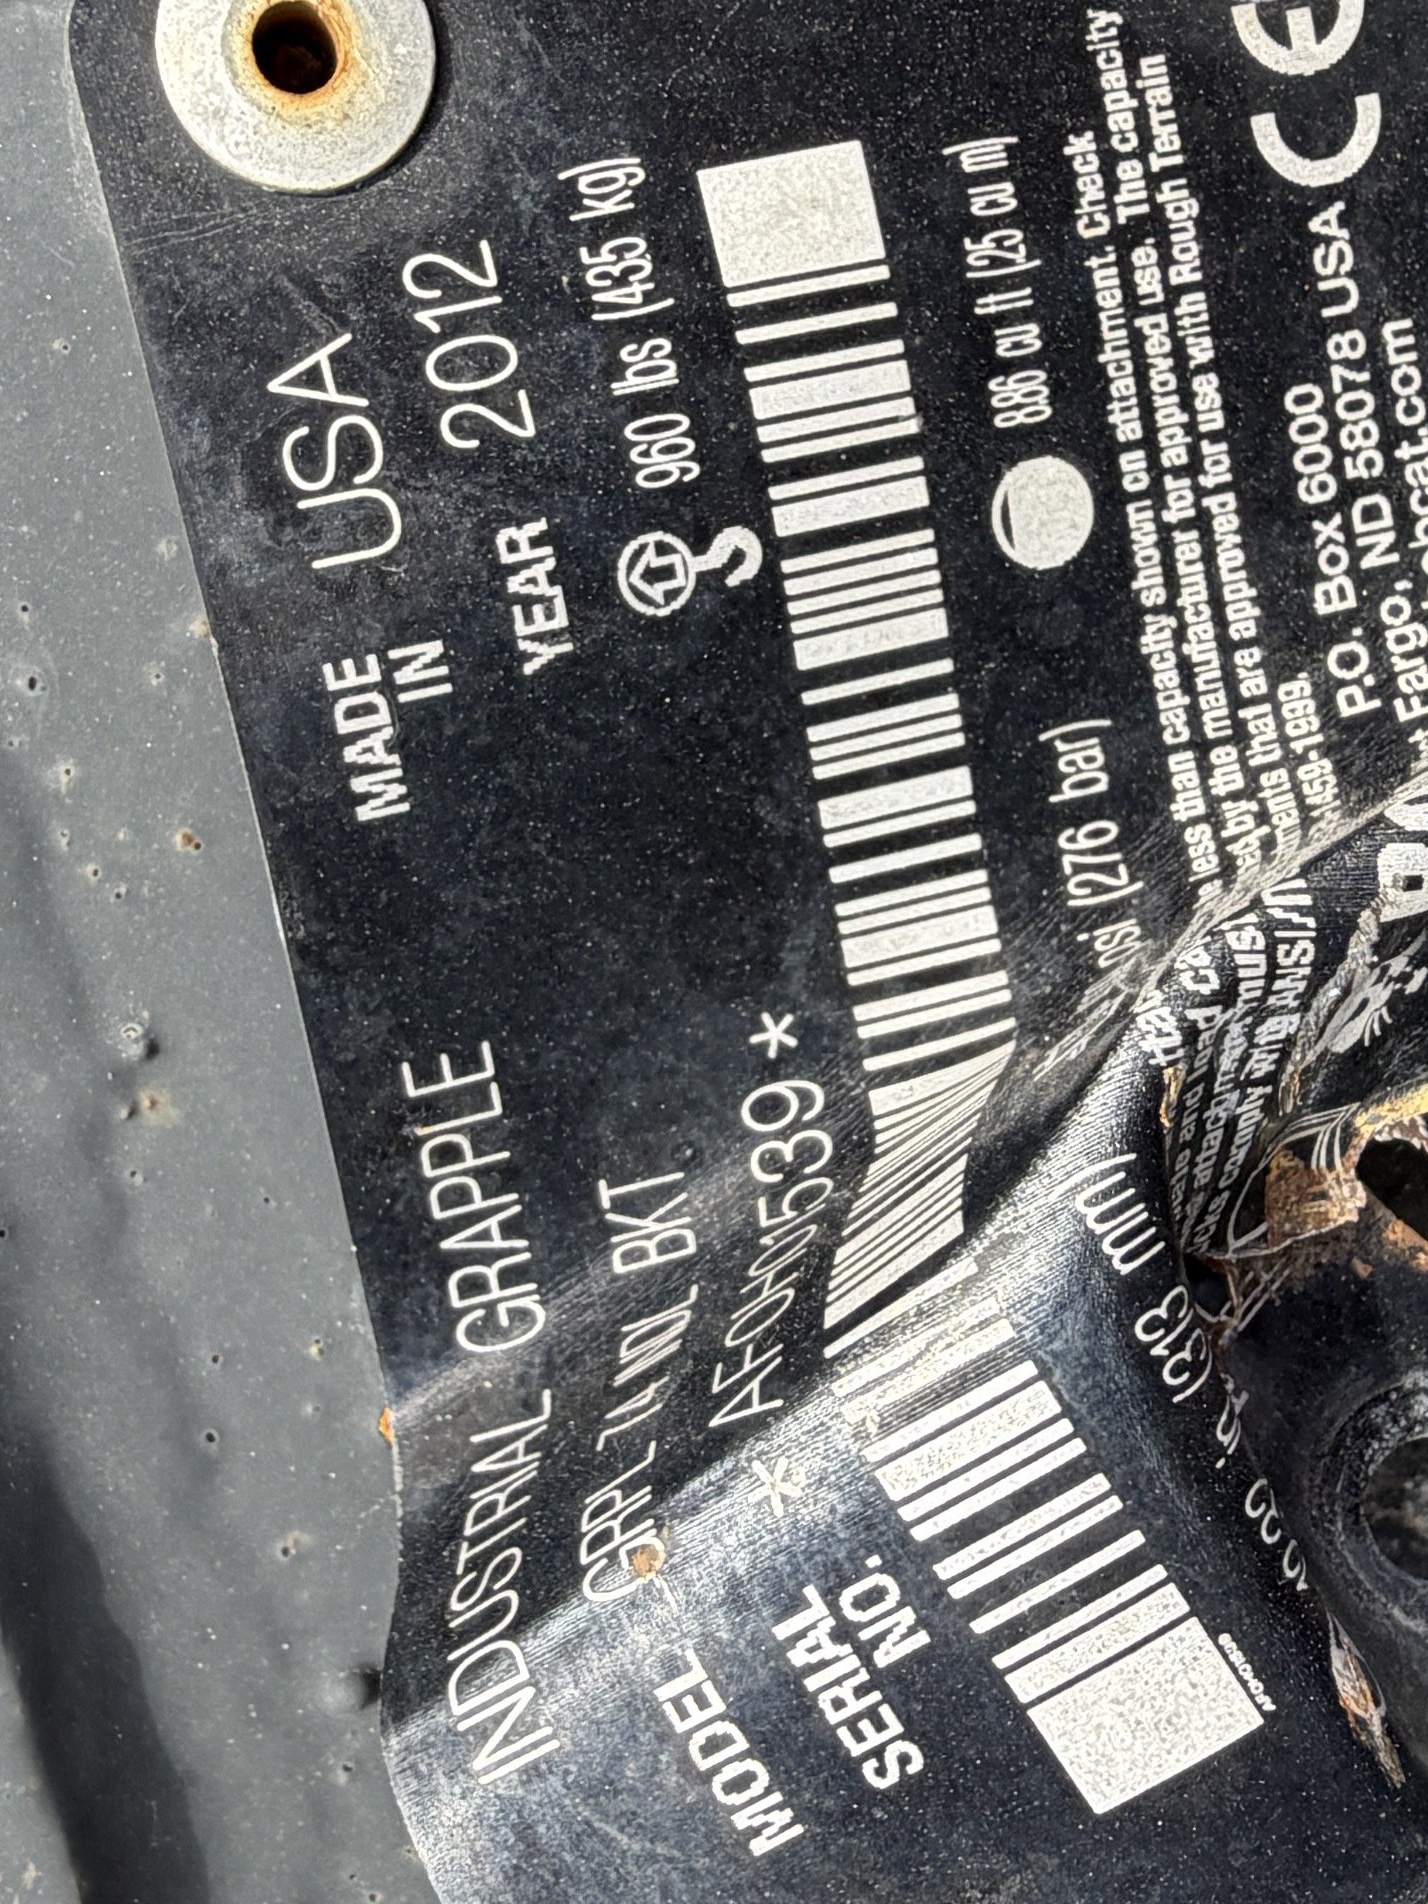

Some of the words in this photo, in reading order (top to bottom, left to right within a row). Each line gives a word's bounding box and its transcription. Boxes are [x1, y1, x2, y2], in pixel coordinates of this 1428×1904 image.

[1085, 9, 1140, 152] capacity
[1136, 54, 1183, 171] Terrain
[558, 157, 645, 220] kg)
[942, 136, 1017, 172] m)
[1063, 131, 1109, 238] Check
[1113, 159, 1149, 223] The
[968, 182, 1016, 215] cu
[1156, 178, 1201, 284] Rough
[579, 236, 674, 320] (435
[975, 287, 1033, 313] ft
[1131, 238, 1163, 304] use.
[1308, 201, 1358, 316] USA
[402, 240, 535, 447] 2012
[611, 338, 678, 395] lbs
[995, 323, 1041, 356] cu
[1084, 246, 1142, 442] attachment.
[1174, 292, 1213, 368] with
[1134, 313, 1191, 467] approved
[1192, 373, 1223, 432] use
[1327, 329, 1383, 478] 58078
[267, 333, 401, 568] USA
[624, 413, 699, 487] 960
[1119, 450, 1149, 491] on
[1198, 440, 1231, 487] for
[1284, 383, 1336, 503] 6000
[1161, 476, 1195, 522] for
[1351, 494, 1399, 568] ND
[495, 517, 572, 674] YEAR
[1126, 499, 1166, 606] shown
[1202, 492, 1258, 639] approved
[1312, 513, 1356, 614] Box
[387, 640, 451, 702] IN
[1172, 530, 1231, 738] manufacturer
[1234, 646, 1267, 696] are
[1327, 627, 1381, 716] P.O.
[1140, 614, 1189, 744] capacity
[322, 654, 409, 820] MADE
[1039, 719, 1111, 802] bar)
[1208, 745, 1243, 795] the
[1238, 703, 1282, 766] that
[1168, 751, 1205, 821] than
[1221, 800, 1258, 837] by
[1058, 820, 1143, 906] (276
[1184, 823, 1219, 881] less
[401, 1041, 551, 1361] GRAPPLE
[598, 1172, 696, 1273] BKT
[443, 1389, 566, 1790] INDUSTRIAL
[839, 1555, 928, 1667] NO.
[772, 1584, 923, 1788] SERIAL
[653, 1641, 803, 1855] MODEL
